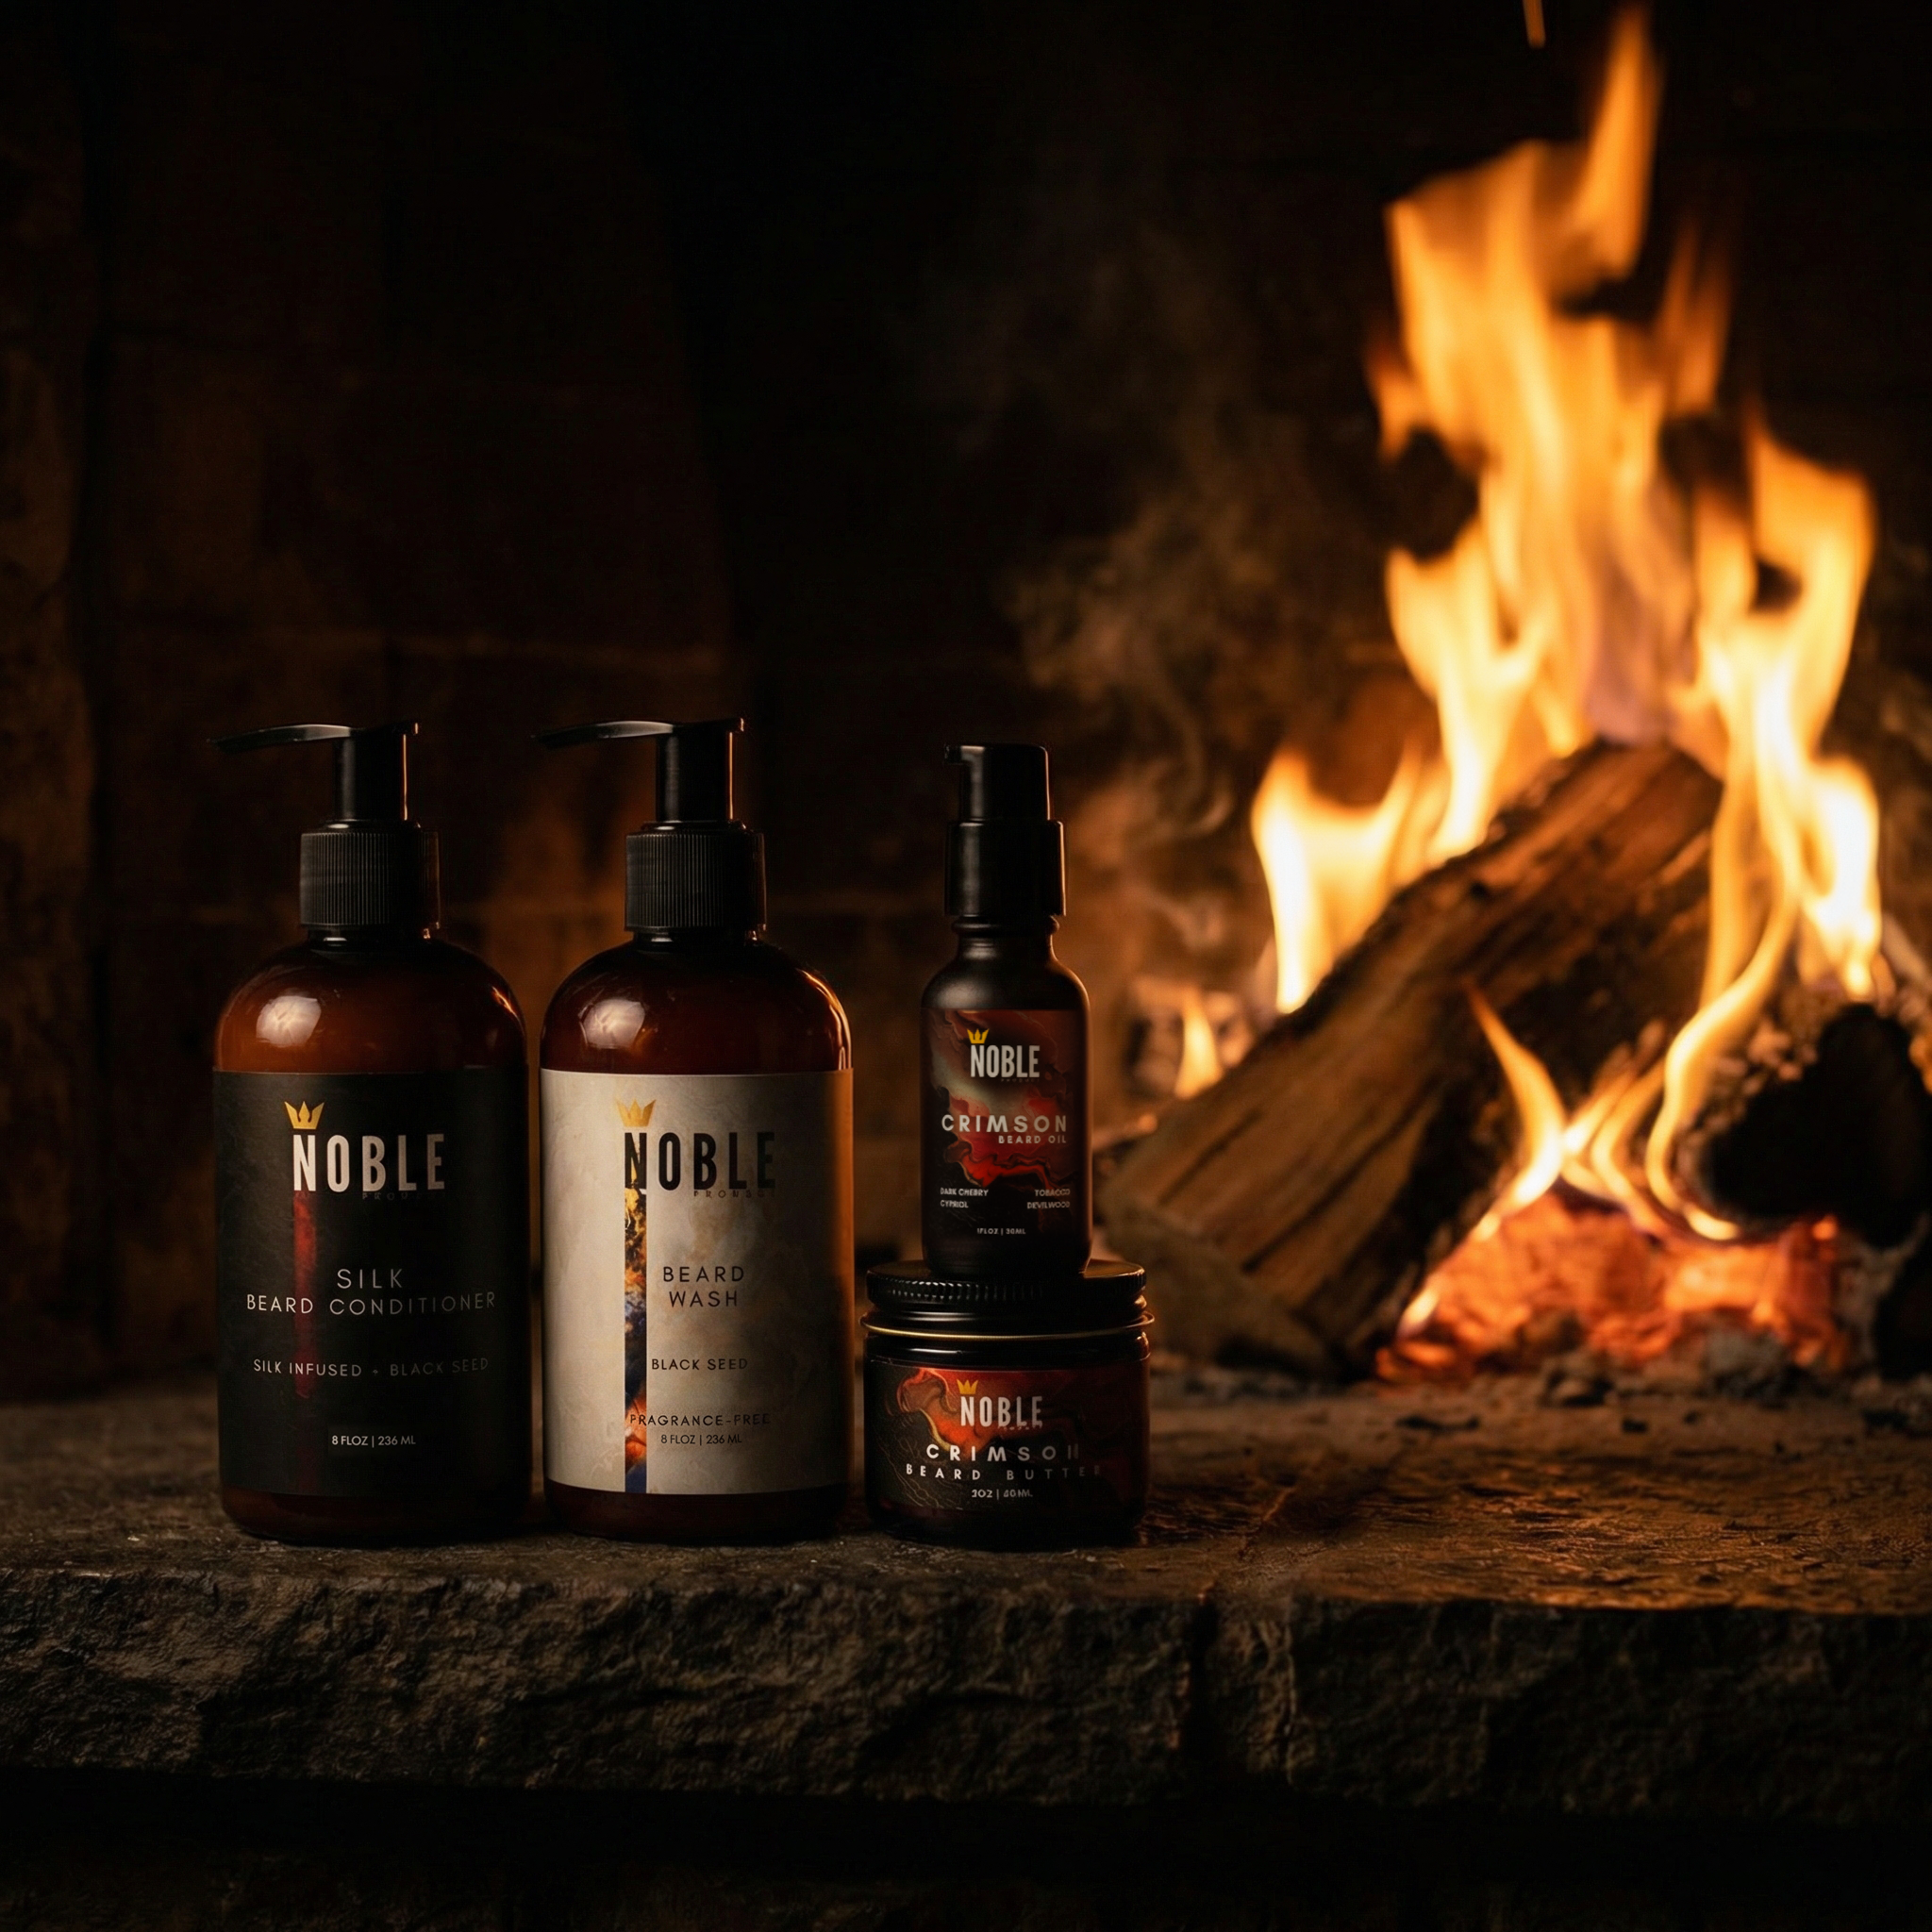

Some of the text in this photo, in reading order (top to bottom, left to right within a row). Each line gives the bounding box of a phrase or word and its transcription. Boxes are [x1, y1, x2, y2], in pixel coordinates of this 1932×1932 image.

[971, 1044, 1041, 1078] NOBLE
[941, 1114, 1067, 1133] CRIMSON
[998, 1135, 1067, 1144] BEARD OIL
[292, 1133, 445, 1193] NOBLE
[625, 1132, 776, 1191] NOBLE
[336, 1268, 403, 1290] SILK
[663, 1265, 744, 1282] BEARD
[246, 1291, 496, 1316] BEARD CONDITIONER
[669, 1291, 738, 1307] WASH
[253, 1357, 282, 1374] SILK
[289, 1361, 362, 1377] INFUSED
[390, 1361, 444, 1377] BLACK
[451, 1357, 490, 1374] SEED
[651, 1358, 749, 1371] BLACK SEED
[960, 1394, 1043, 1428] NOBLE
[331, 1435, 339, 1445] 8
[341, 1435, 369, 1446] FLOZ
[377, 1435, 398, 1446] 236
[400, 1434, 416, 1445] ML
[660, 1434, 668, 1444] 8
[670, 1434, 696, 1444] FLOZ
[706, 1434, 725, 1444] 236
[727, 1434, 742, 1444] ML
[906, 1463, 981, 1480] BEARD
